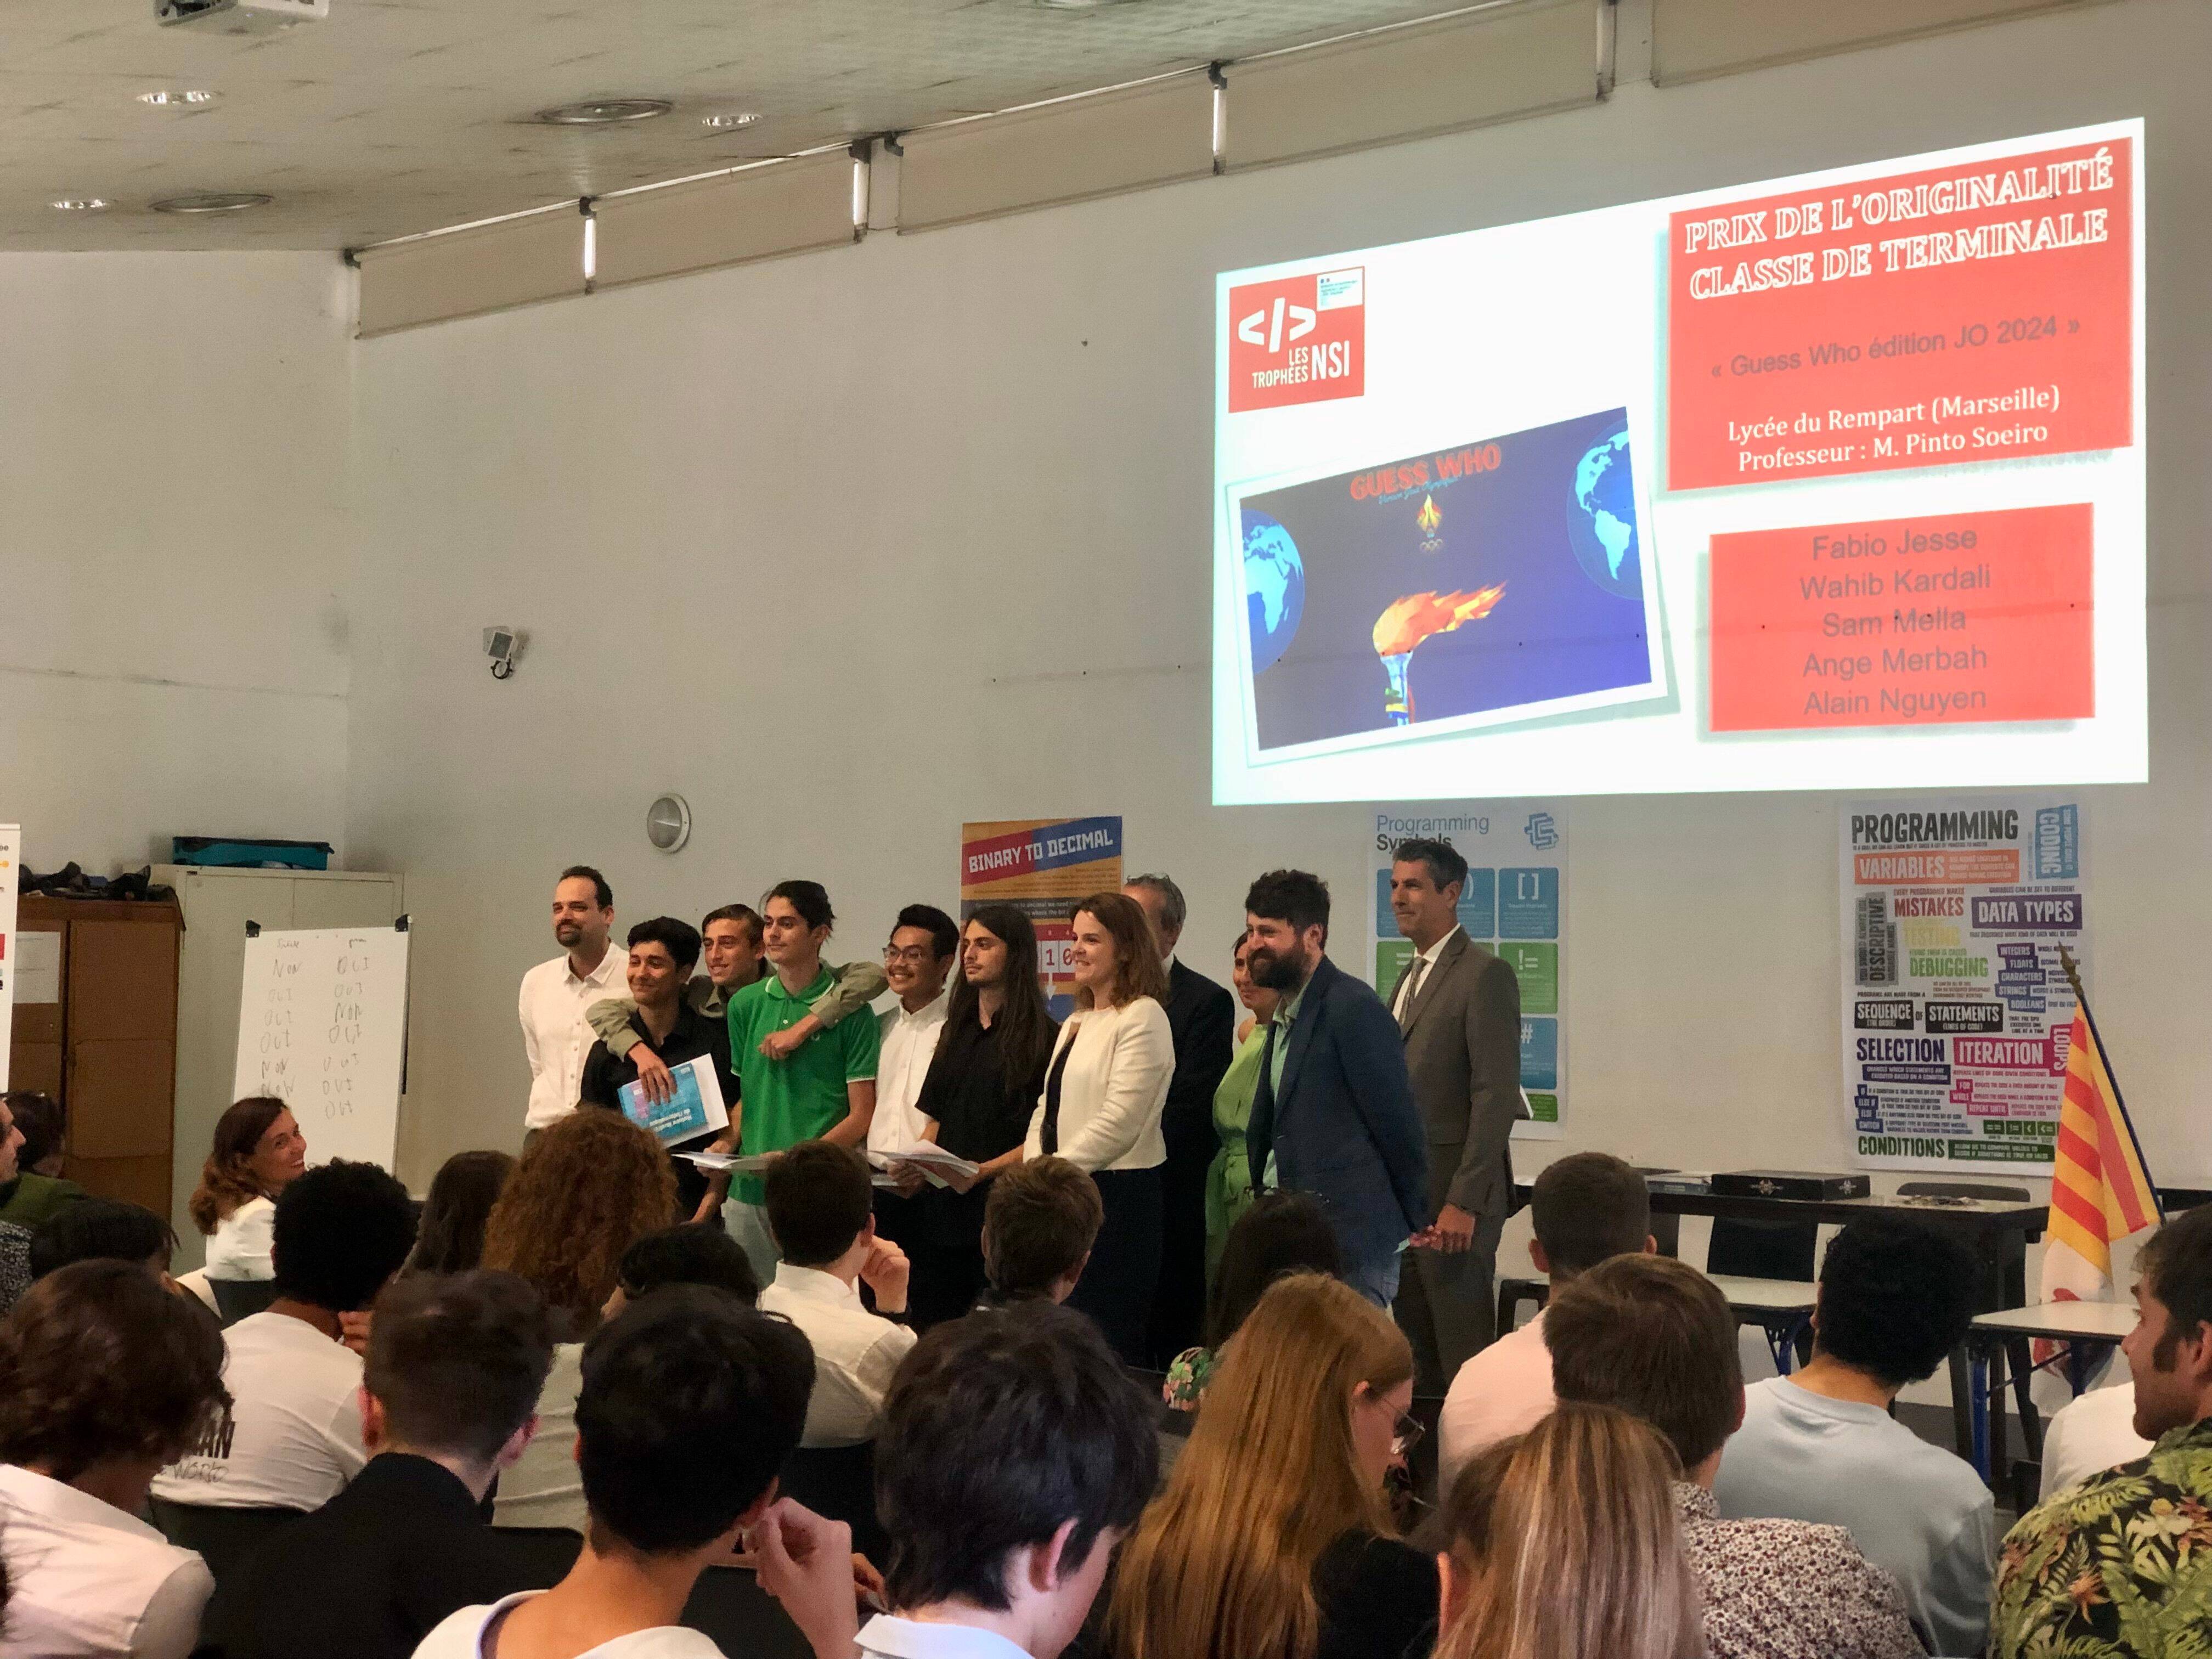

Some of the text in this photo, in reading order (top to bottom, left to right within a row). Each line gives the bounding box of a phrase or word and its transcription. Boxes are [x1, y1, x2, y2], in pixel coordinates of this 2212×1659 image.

[1685, 211, 1767, 253] PRIX
[1775, 202, 1823, 239] DE
[1689, 207, 2108, 300] CLASSE DE TERMINALE
[1289, 346, 1308, 366] LES
[1731, 353, 1801, 376] Guess
[1809, 343, 1861, 366] Who
[1869, 333, 1945, 358] édition
[1954, 324, 1989, 348] JO
[1997, 315, 2057, 344] 2024
[1312, 340, 1350, 380] NSI
[1252, 364, 1308, 388] TROPHÉES
[1729, 385, 2059, 445] Lycée du Rempart (Marseille)
[1739, 445, 1855, 472] Professeur
[1874, 436, 1899, 458] M.
[1906, 432, 1966, 455] Pinto
[1972, 423, 2048, 448] Soeiro
[1350, 443, 1501, 500] GUESS WHO
[1813, 528, 1977, 560] Fabio Jesse
[1800, 563, 1990, 600] Wahib Kardali
[1822, 606, 1966, 637] Sam Mella
[1803, 644, 1987, 681] Ange Merbah
[1804, 688, 1986, 718] Alain Nguyen
[1377, 814, 1489, 835] Programming
[1852, 810, 2018, 843] PROGRAMMING
[969, 830, 1113, 873] BINARY TO DECIMAL
[2039, 813, 2062, 873] CODING
[1860, 856, 1945, 879] VARIABLES
[1894, 897, 1964, 917] MISTAKES
[1979, 901, 2074, 923] DATA TYPES
[2000, 946, 2030, 955] INTEGERS
[2011, 960, 2033, 968] FLOATS
[1910, 957, 1988, 977] DEBUGGING
[2001, 973, 2043, 981] CHARACTERS
[1999, 986, 2027, 995] STRINGS
[1858, 1004, 1911, 1019] SEQUENCE
[1929, 1006, 1999, 1022] STATEMENTS
[1857, 1038, 1944, 1062] SELECTION
[1959, 1042, 2044, 1064] ITERATION
[1858, 1137, 1945, 1158] CONDITIONS
